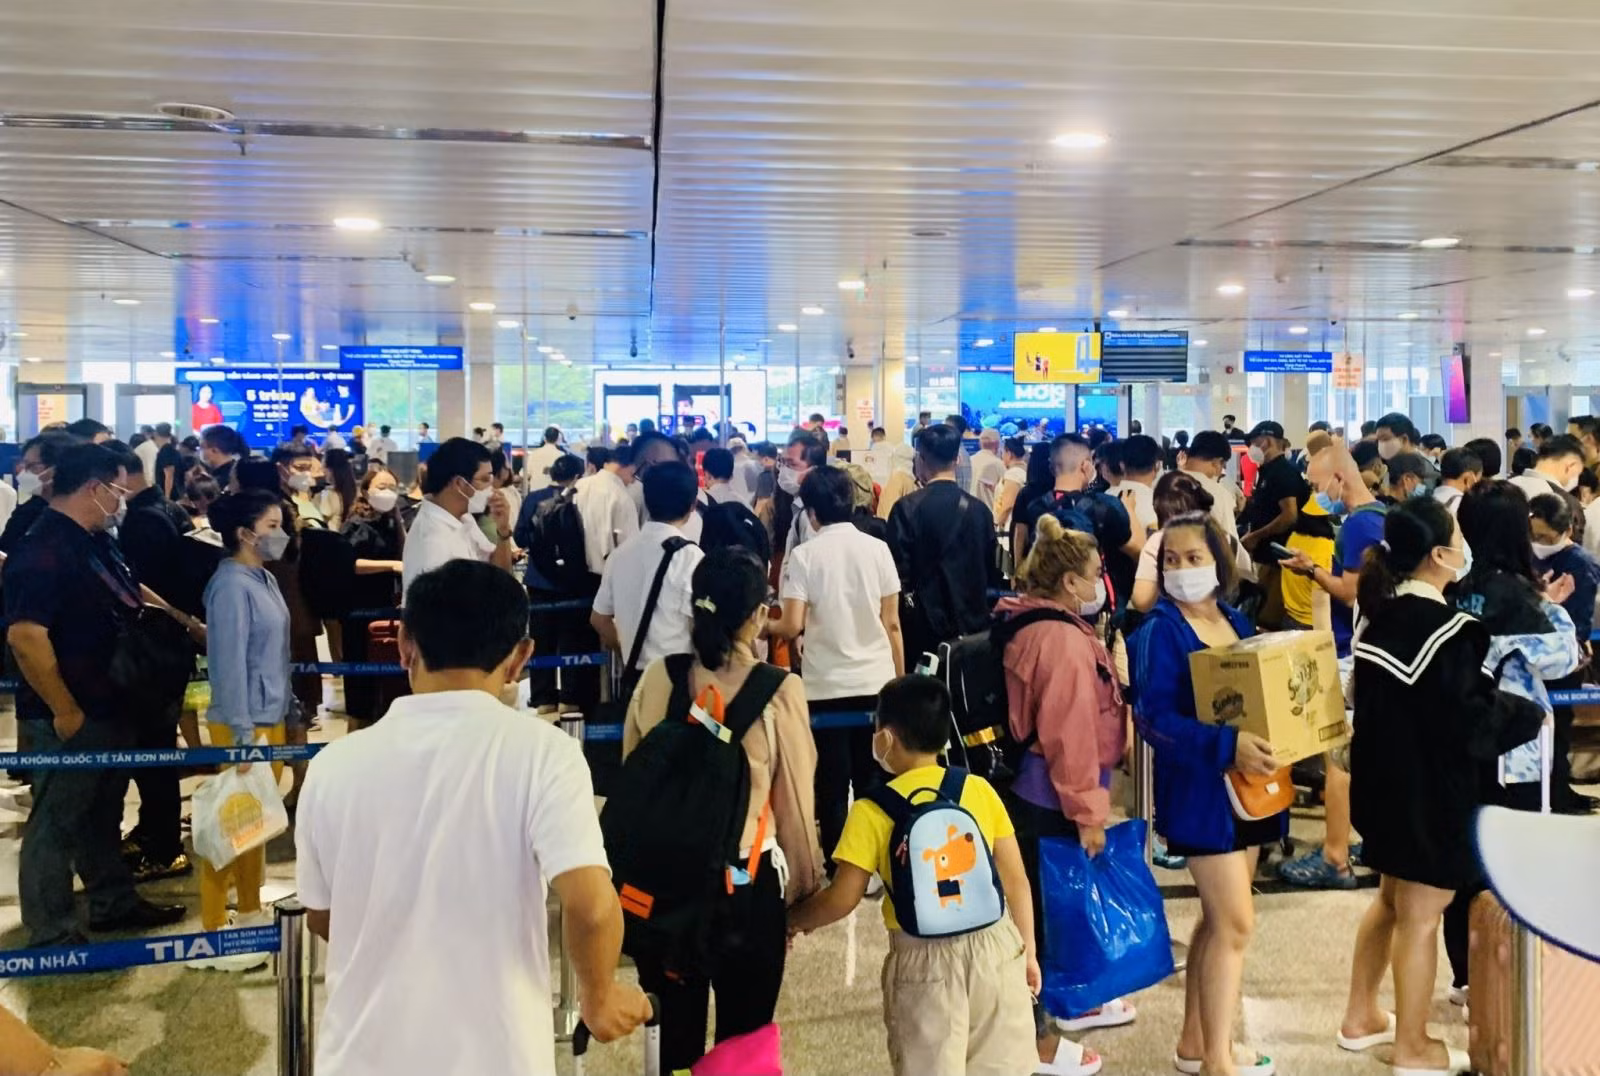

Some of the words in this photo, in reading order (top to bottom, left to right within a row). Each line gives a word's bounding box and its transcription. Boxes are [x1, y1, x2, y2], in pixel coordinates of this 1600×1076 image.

[562, 655, 592, 665] TIA
[111, 752, 133, 763] TÂN
[225, 748, 265, 761] TIA
[145, 936, 216, 961] TIA
[0, 956, 34, 974] SƠN
